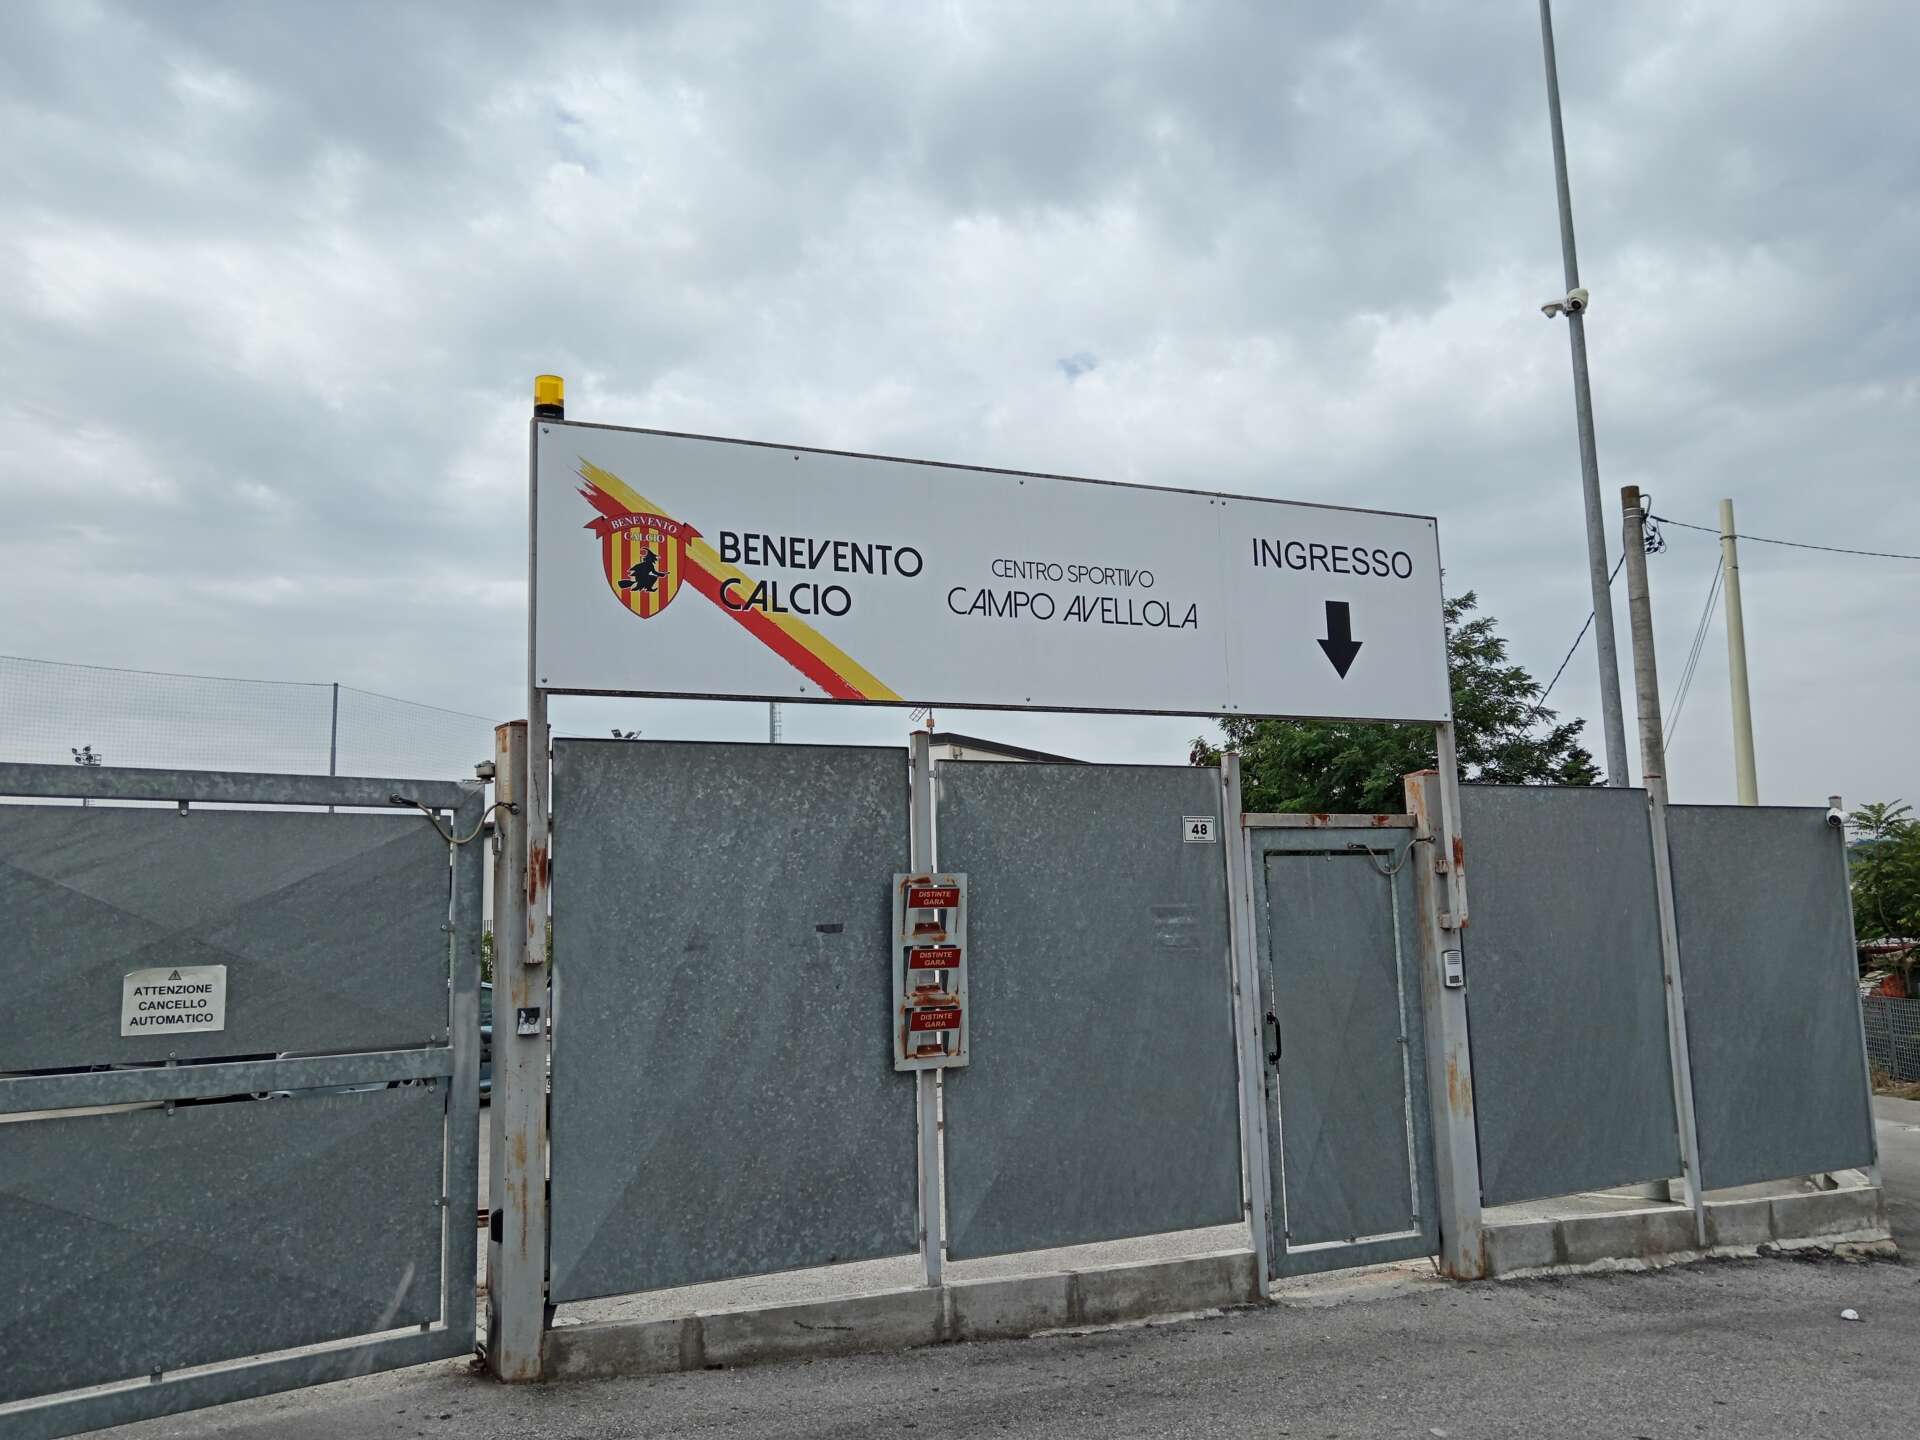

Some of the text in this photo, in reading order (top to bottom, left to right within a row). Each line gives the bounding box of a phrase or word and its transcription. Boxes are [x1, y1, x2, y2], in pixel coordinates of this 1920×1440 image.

[611, 516, 678, 534] BENEVENTO
[623, 532, 665, 543] CALCIO
[719, 531, 923, 577] BENEVENTO
[1252, 538, 1413, 579] INGRESSO
[991, 558, 1155, 588] CENTRO SPORTIVO
[719, 578, 852, 616] CALCIO
[947, 586, 1198, 629] CAMPO AVELLOLA
[1191, 823, 1208, 835] 48
[919, 951, 953, 959] DISTINTE
[133, 984, 213, 996] ATTENZIONE
[138, 999, 207, 1011] CANCELLO
[129, 1013, 214, 1026] AUTOMATICO
[920, 1012, 953, 1020] DISTINTE
